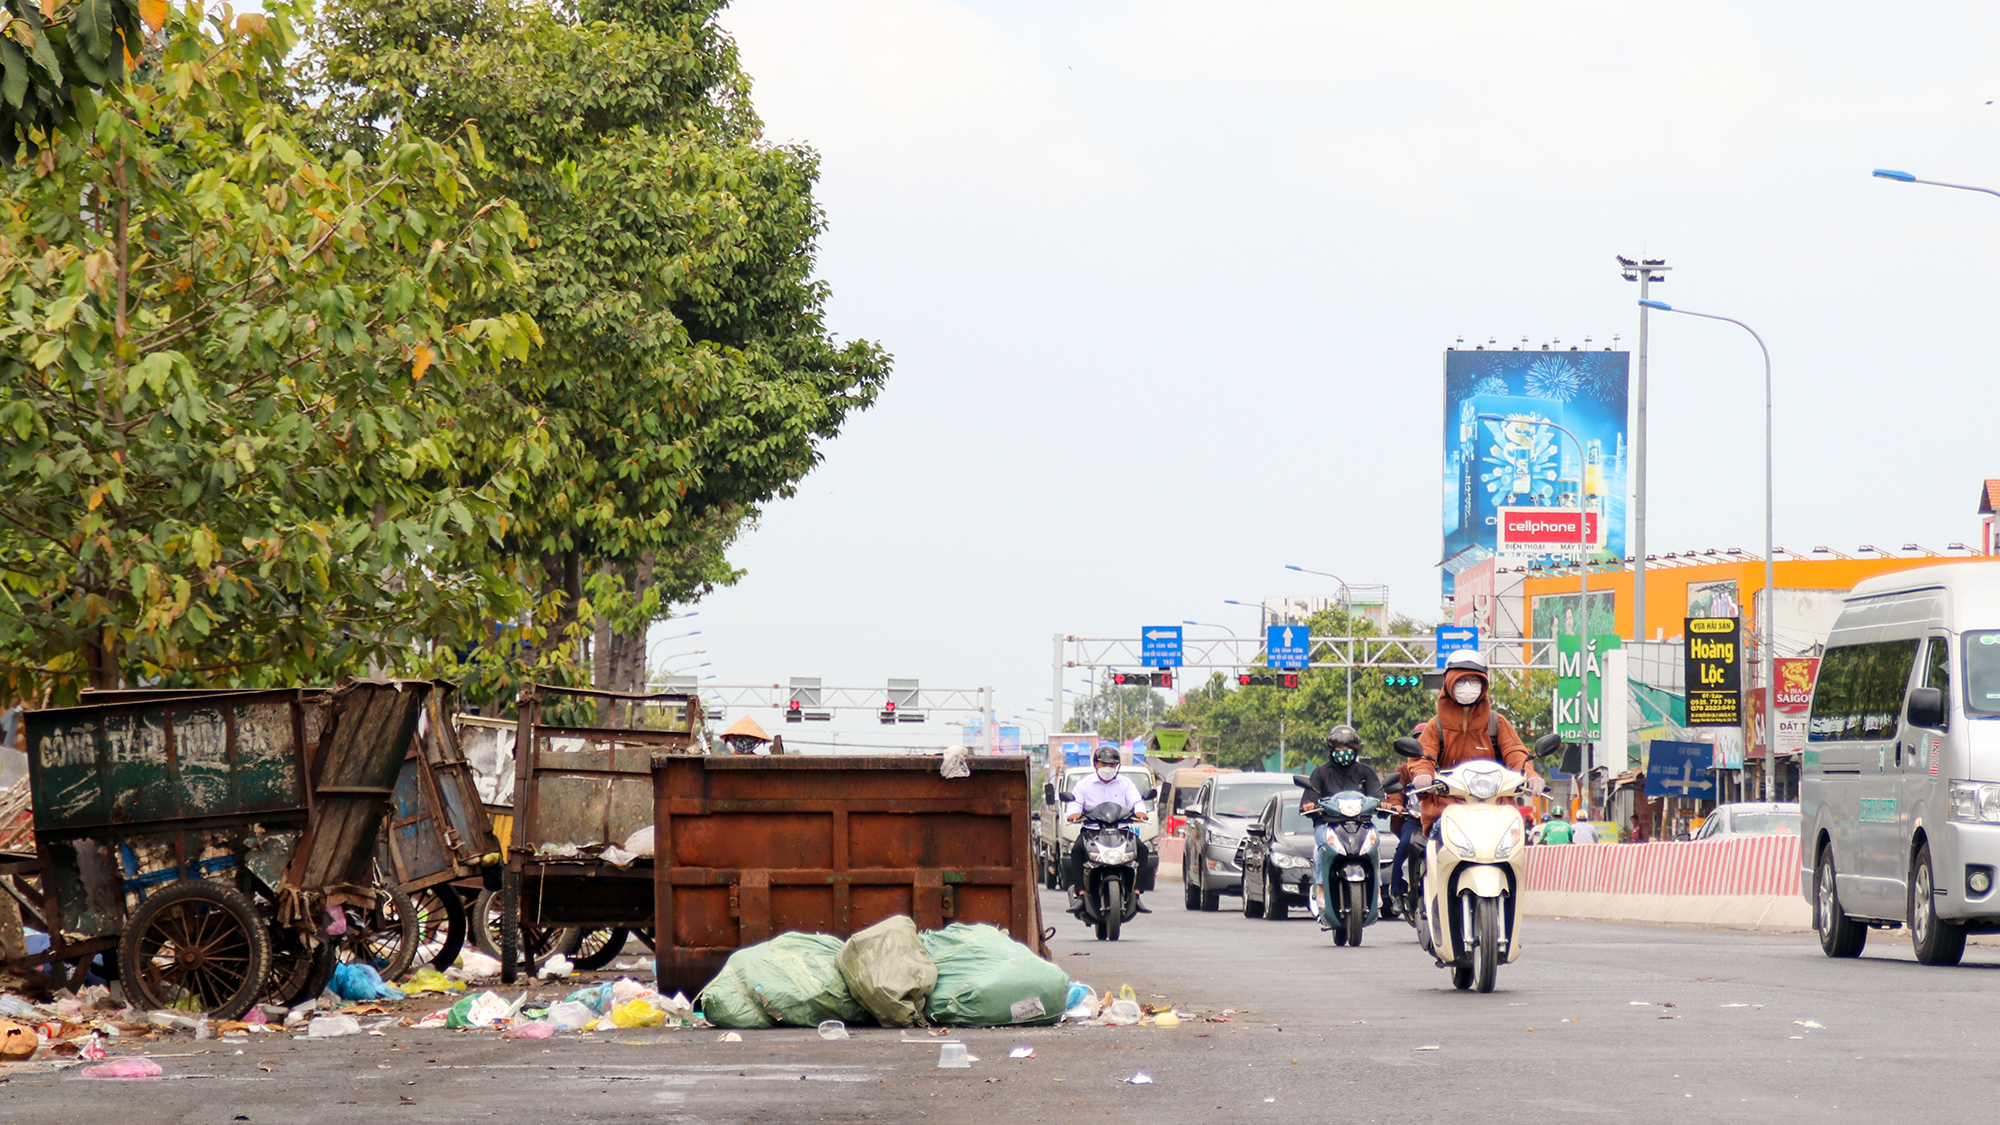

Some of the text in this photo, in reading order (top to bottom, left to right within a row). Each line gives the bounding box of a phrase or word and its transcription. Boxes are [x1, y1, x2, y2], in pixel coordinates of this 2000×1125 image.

[1706, 621, 1717, 630] HẢI
[1718, 621, 1731, 630] SẢN
[1559, 638, 1601, 678] MẮ
[1690, 637, 1734, 664] Hoàng
[1700, 663, 1725, 688] Lộc
[1558, 691, 1599, 725] KÍN
